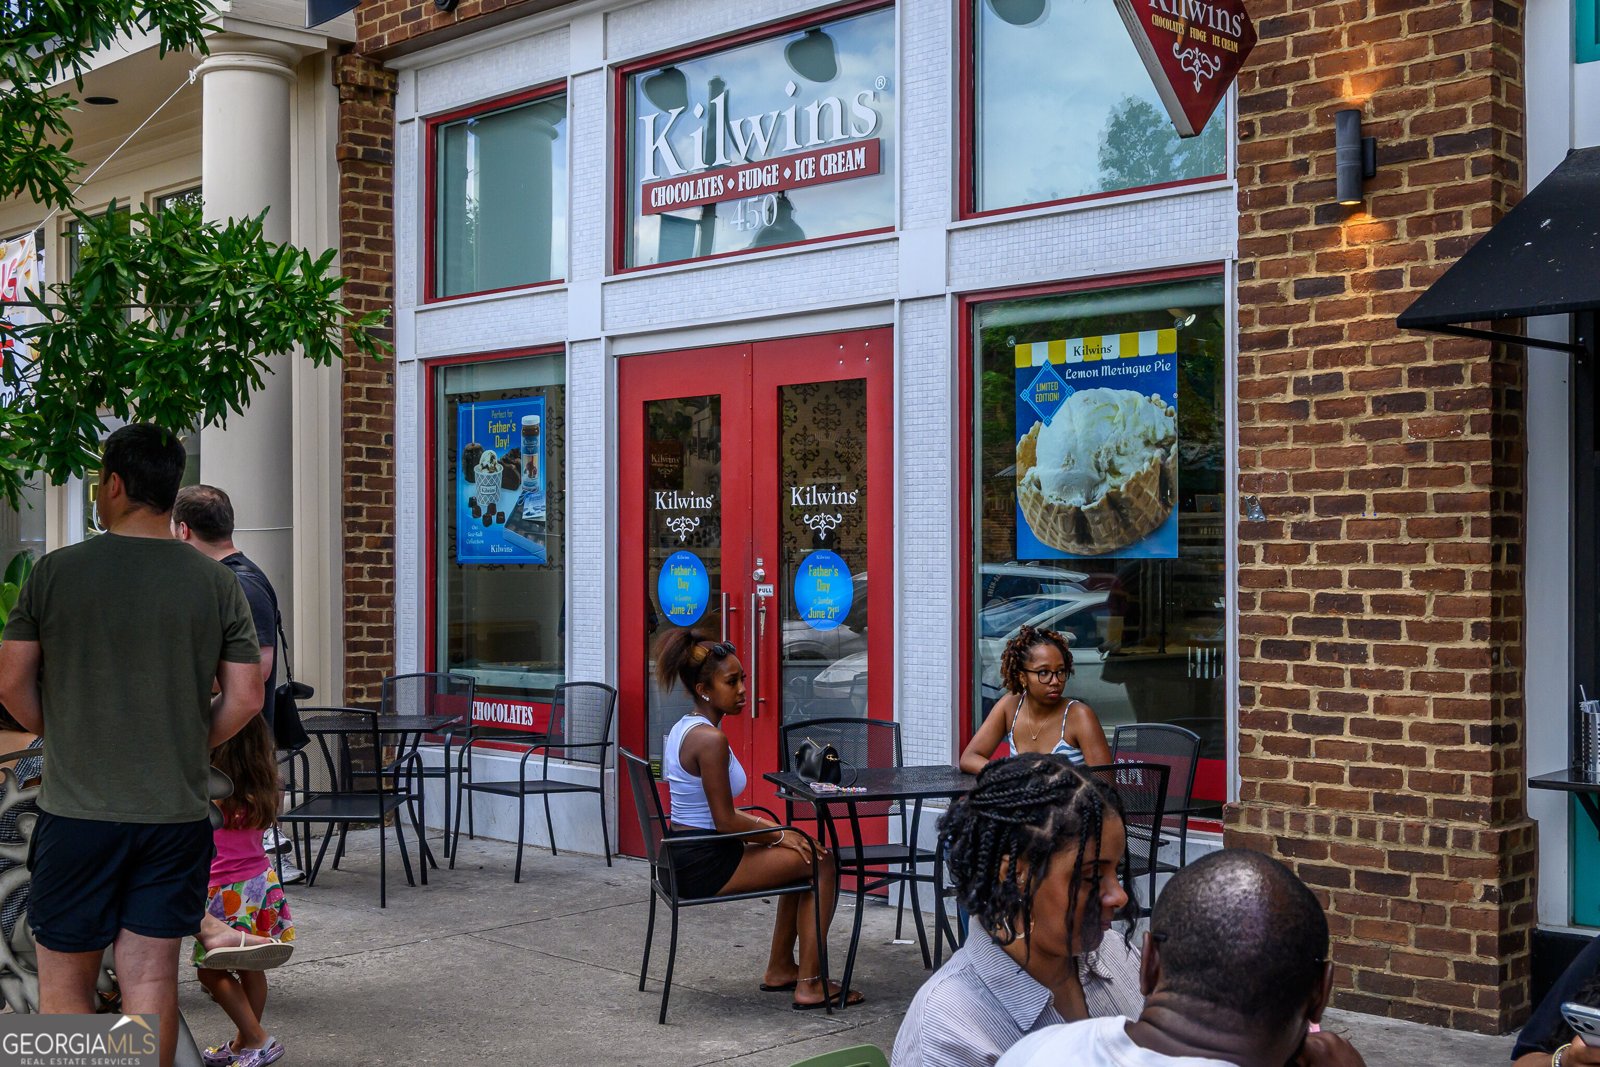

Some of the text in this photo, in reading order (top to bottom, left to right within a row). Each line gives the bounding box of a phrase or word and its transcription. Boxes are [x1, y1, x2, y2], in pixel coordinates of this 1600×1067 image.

[1151, 14, 1239, 54] CHOCOLATES FUDGE ICE CREAM
[651, 147, 866, 208] CHOCOLATES FUDGE ICE CREAM
[730, 194, 778, 231] 450
[1065, 359, 1172, 380] Lemon Meringue Pie
[1036, 381, 1059, 392] LIMITED
[488, 419, 516, 434] Father's
[495, 434, 510, 450] Day!
[670, 564, 697, 576] Father's
[808, 564, 839, 577] Father's
[677, 577, 689, 591] Day
[816, 579, 830, 593] Day
[670, 603, 685, 615] June
[808, 607, 825, 619] June
[471, 701, 534, 726] CHOCOLATES
